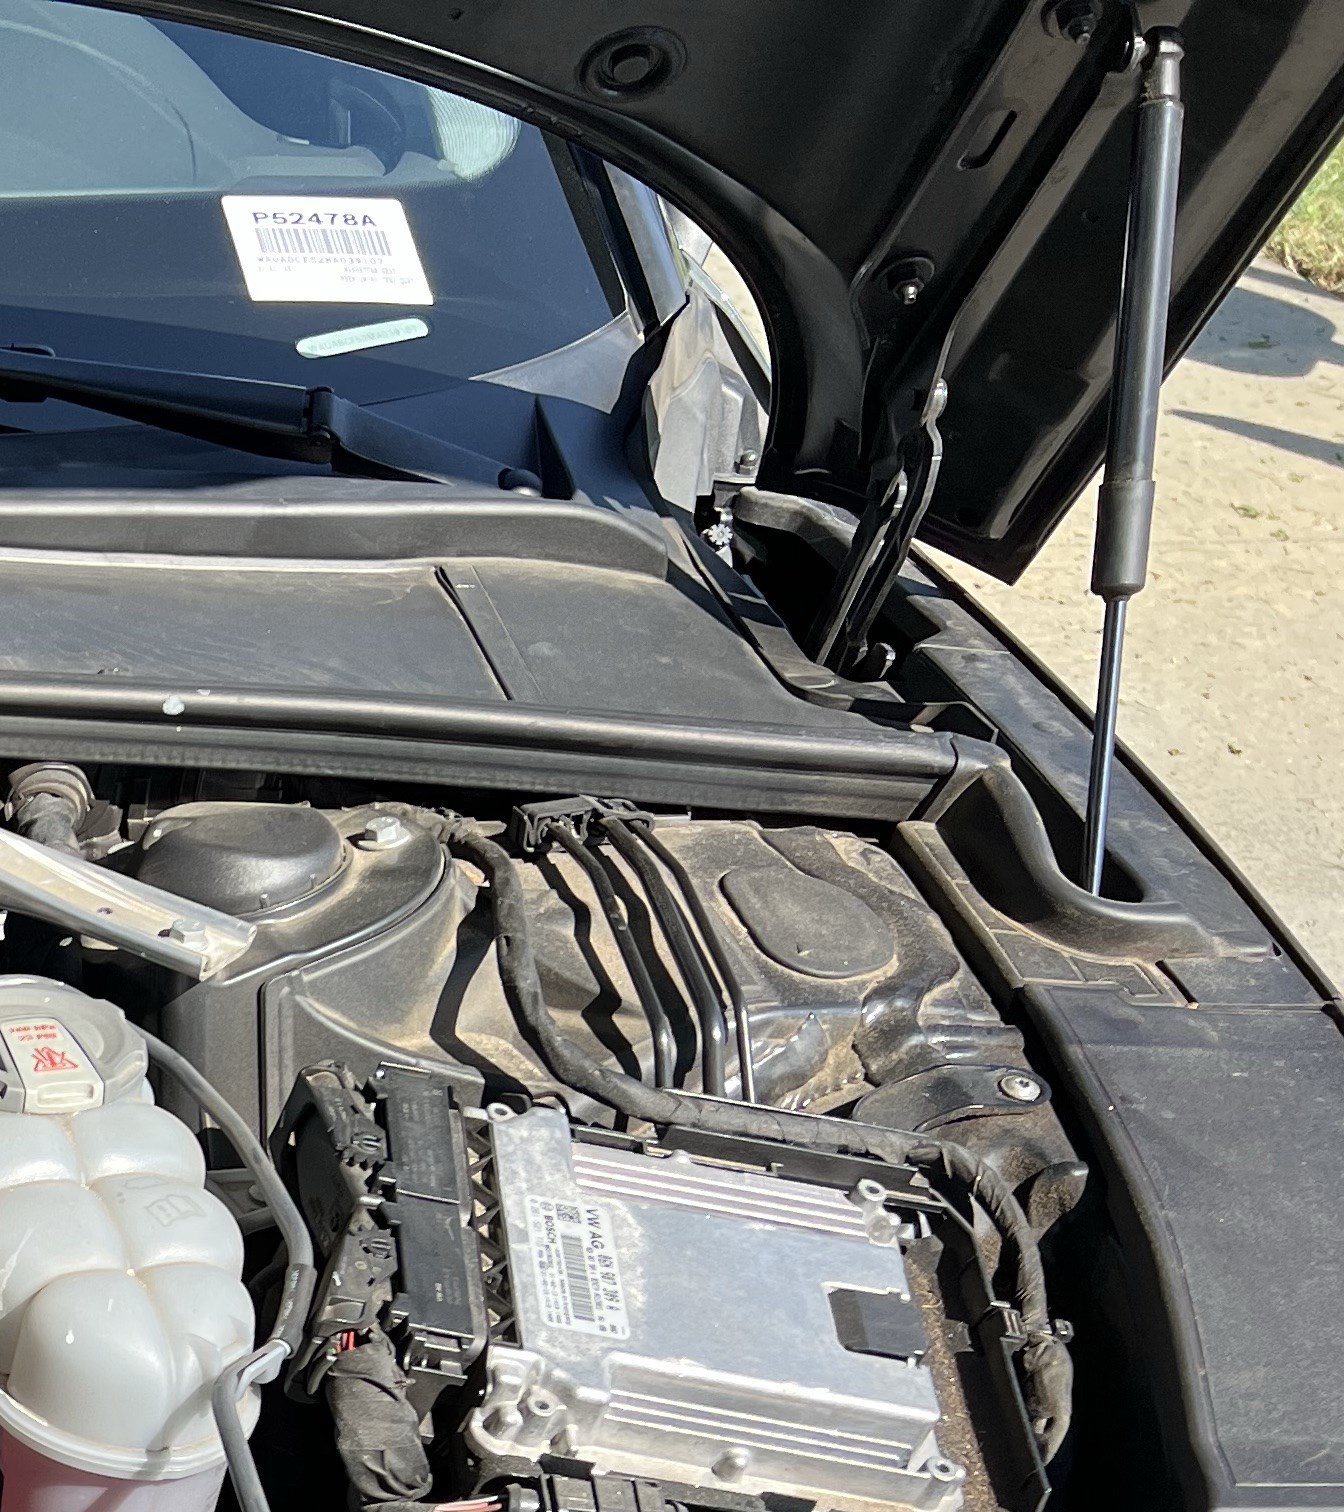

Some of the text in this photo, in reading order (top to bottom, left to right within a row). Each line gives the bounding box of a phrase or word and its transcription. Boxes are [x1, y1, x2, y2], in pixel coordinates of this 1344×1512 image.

[252, 212, 376, 226] P52478A
[586, 1208, 602, 1229] VW
[544, 1215, 557, 1244] BOSCH
[589, 1230, 605, 1250] AG
